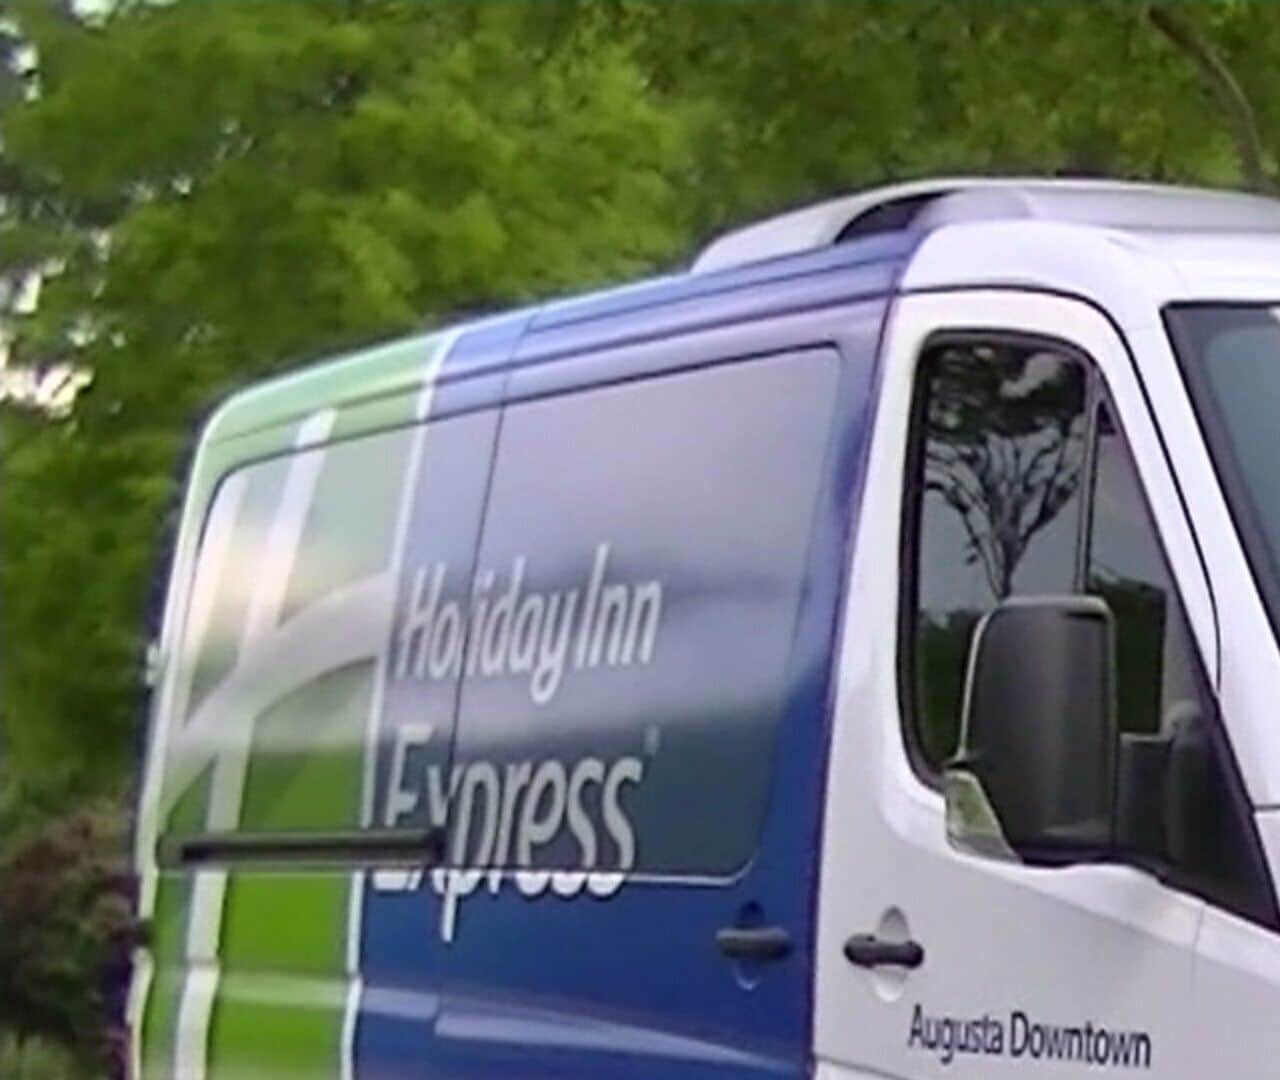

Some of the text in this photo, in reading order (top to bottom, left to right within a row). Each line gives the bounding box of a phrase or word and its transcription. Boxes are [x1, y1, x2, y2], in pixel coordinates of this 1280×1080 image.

[395, 541, 663, 705] Holiday Inn
[371, 722, 644, 943] Express
[907, 1003, 1152, 1068] Augusta Downtown
